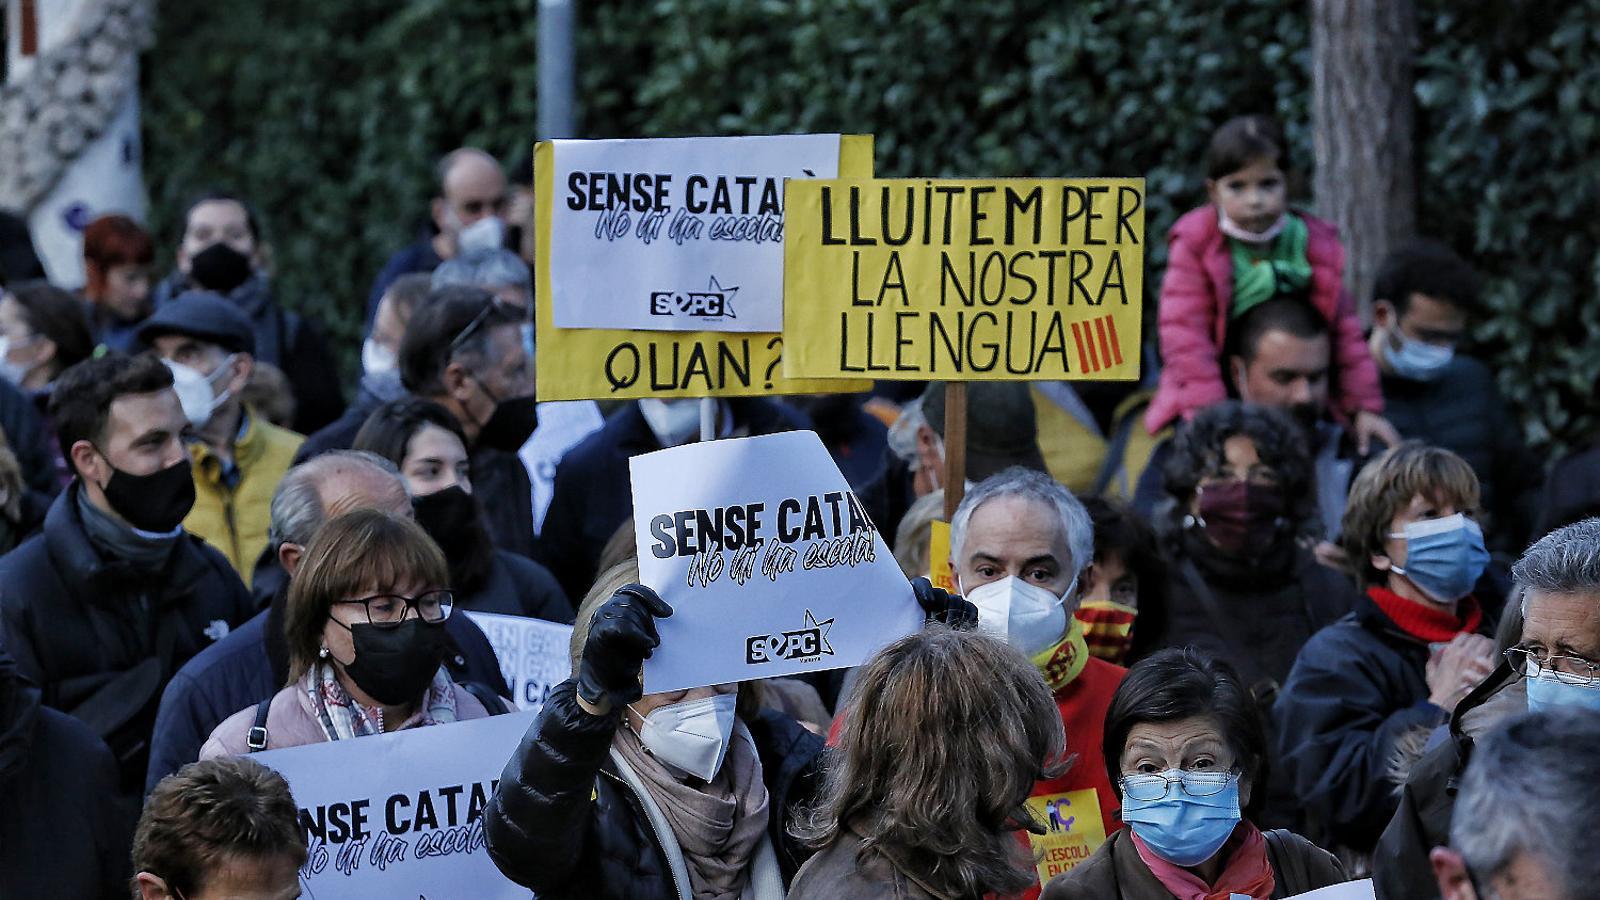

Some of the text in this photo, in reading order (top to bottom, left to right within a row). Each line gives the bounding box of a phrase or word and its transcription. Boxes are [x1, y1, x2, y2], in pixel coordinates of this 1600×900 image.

[567, 171, 671, 212] SENSE
[1061, 186, 1142, 246] PER
[595, 201, 632, 241] No
[669, 207, 704, 245] ha
[852, 250, 1128, 306] LA NOSTRA
[840, 311, 1070, 374] LLENGUA
[650, 502, 765, 559] SENSE
[688, 540, 724, 588] No
[762, 538, 797, 582] ha
[385, 779, 499, 836] CATA
